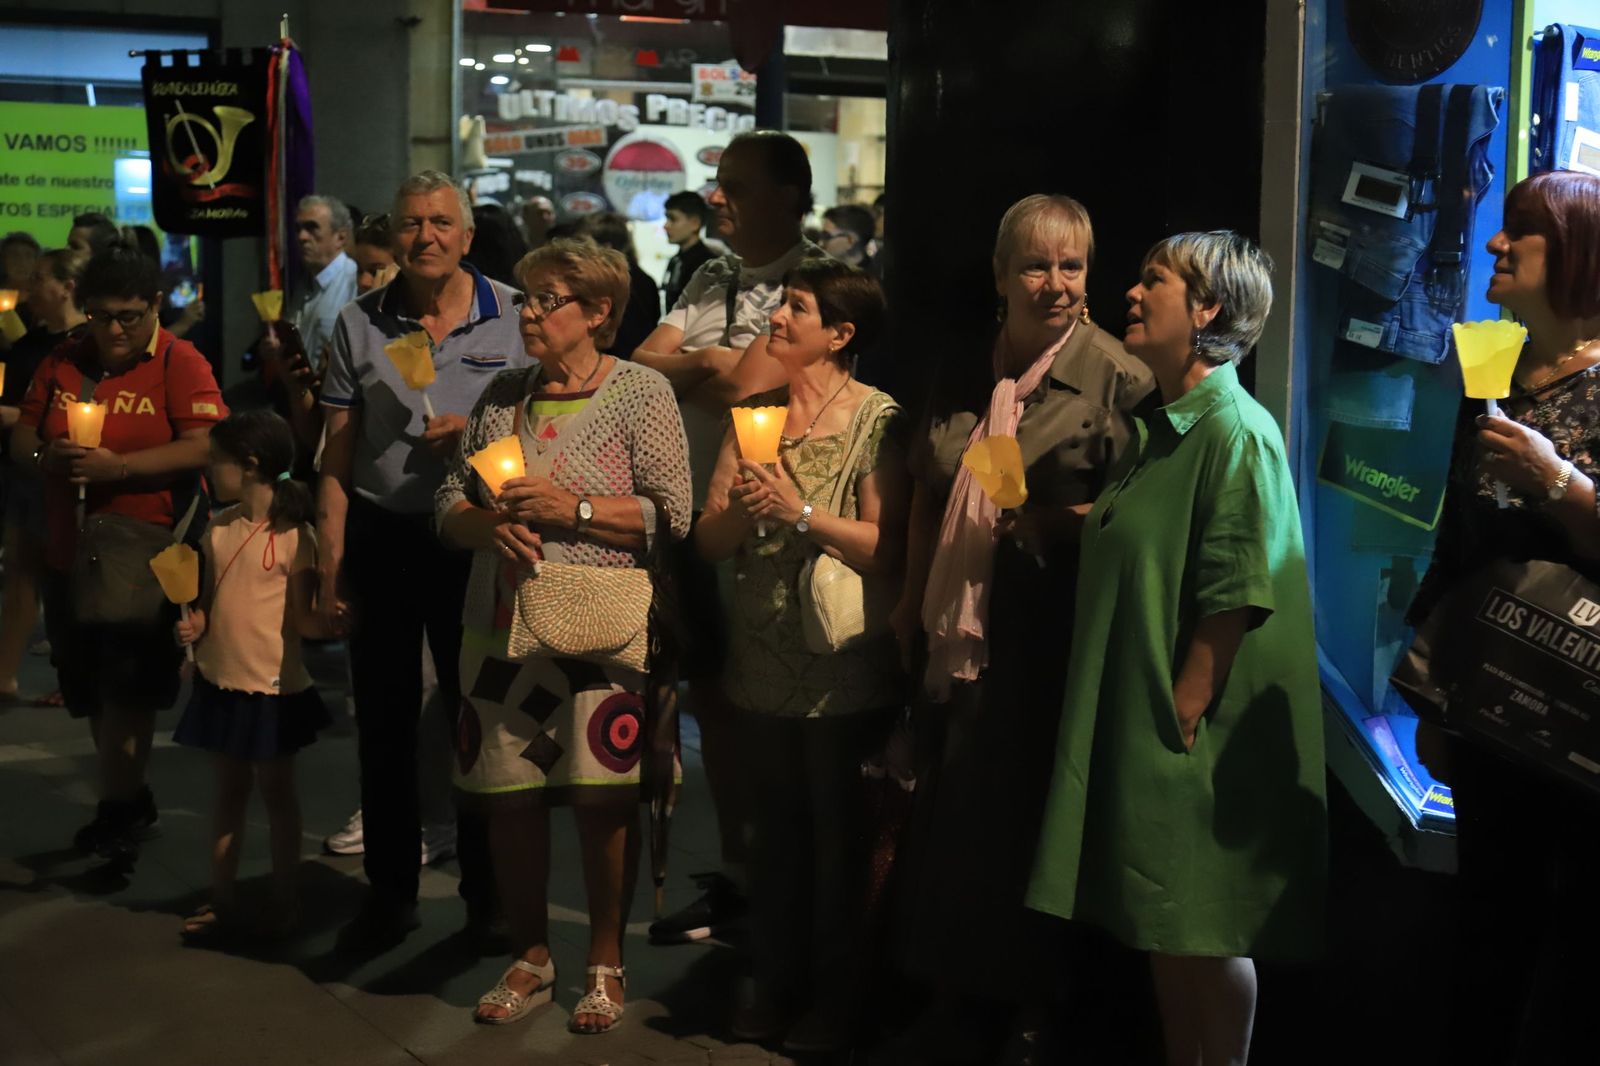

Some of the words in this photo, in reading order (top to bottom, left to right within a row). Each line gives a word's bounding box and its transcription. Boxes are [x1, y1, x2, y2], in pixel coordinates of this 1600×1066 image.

[4, 133, 87, 153] VAMOS
[25, 174, 46, 187] de
[1344, 453, 1422, 503] Wrangler
[1485, 596, 1528, 630] LOS
[1508, 689, 1549, 716] ZAMORA
